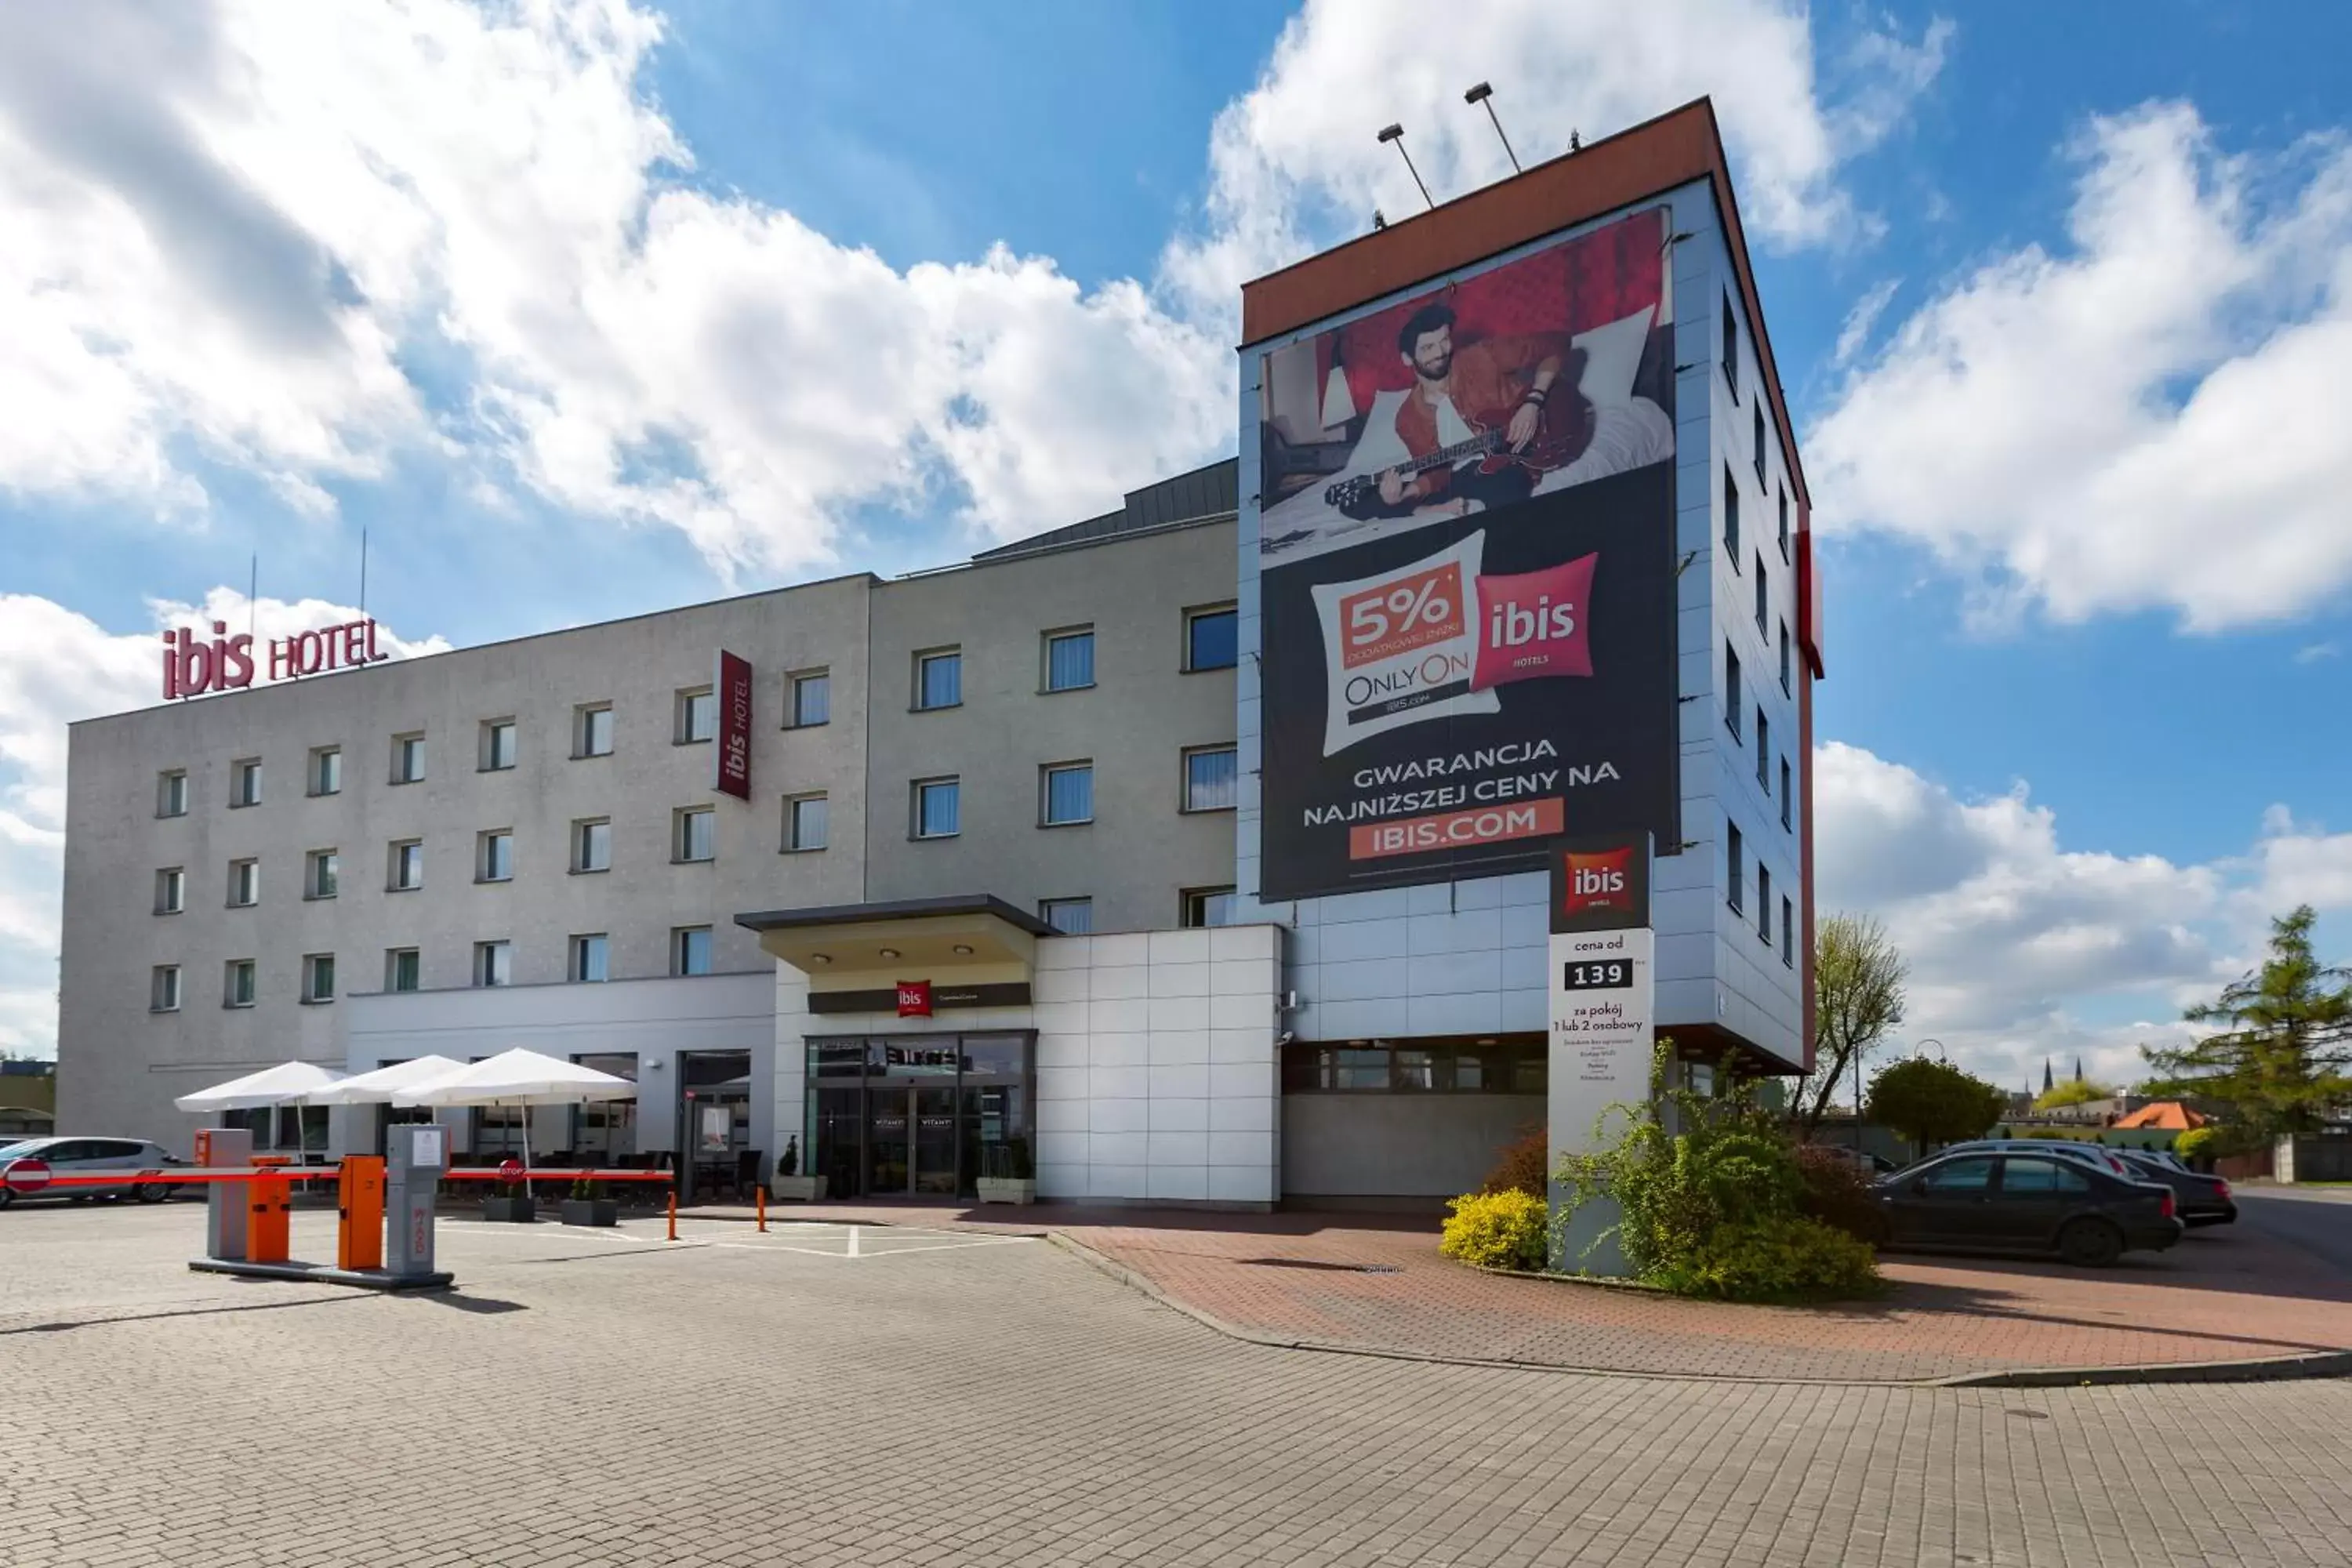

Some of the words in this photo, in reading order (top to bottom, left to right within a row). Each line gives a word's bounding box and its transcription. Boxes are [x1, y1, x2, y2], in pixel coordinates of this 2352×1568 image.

[1491, 596, 1575, 648] ibis
[163, 621, 255, 699] ibis
[268, 617, 389, 681] HOTEL
[1513, 655, 1549, 667] HOTELS
[735, 679, 747, 730] HOTEL
[726, 734, 746, 780] ibis
[1354, 739, 1558, 788] GWARANCJA
[1304, 786, 1465, 826] NAJNIŻSZEJ
[1474, 770, 1559, 800] CENY
[1569, 761, 1621, 786] NA
[1374, 808, 1537, 852] IBIS.COM
[1575, 866, 1624, 895] ibis
[1575, 941, 1603, 951] cena
[1607, 935, 1624, 949] od
[1574, 964, 1622, 985] 139
[899, 991, 921, 1004] ibis
[1590, 1001, 1622, 1018] pokój
[1555, 1022, 1559, 1031] 1
[1563, 1019, 1579, 1031] lub
[1582, 1021, 1590, 1031] 2
[1593, 1018, 1642, 1033] osobowy
[502, 1167, 523, 1176] STOP
